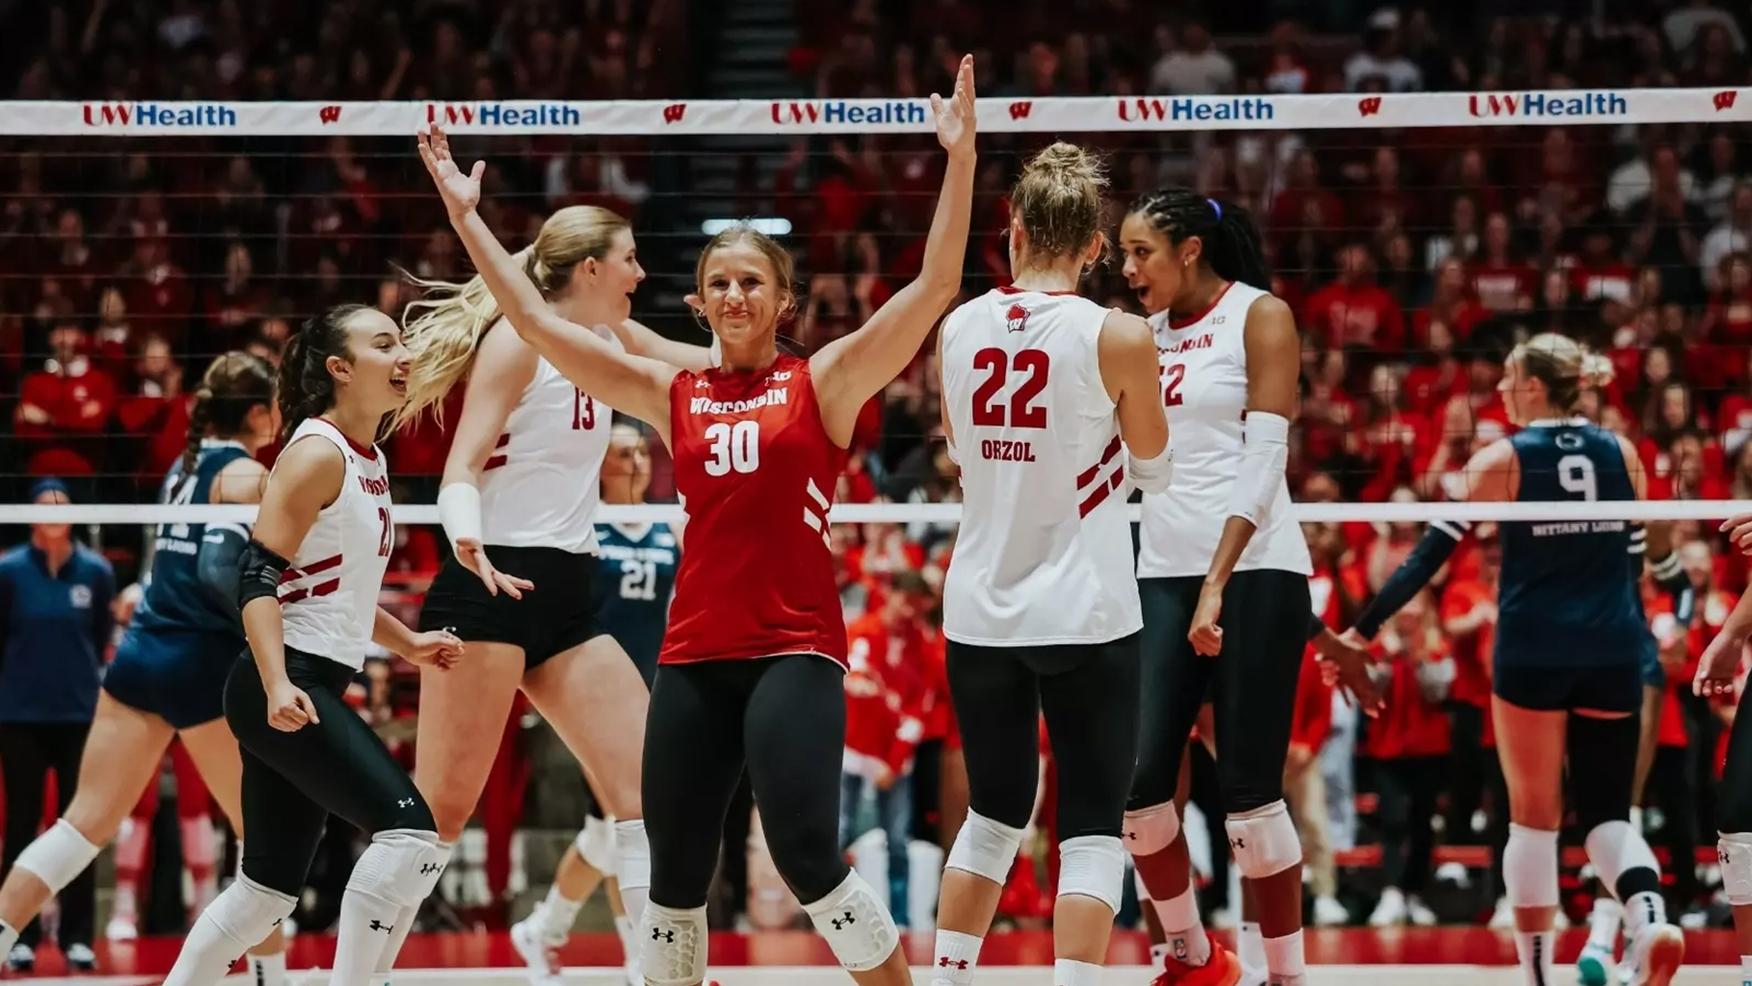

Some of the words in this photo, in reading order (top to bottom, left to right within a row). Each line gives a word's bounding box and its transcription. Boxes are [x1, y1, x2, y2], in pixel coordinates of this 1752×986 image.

[572, 385, 595, 430] 13
[690, 387, 788, 415] WISCONSIN
[972, 347, 1050, 429] 22
[704, 420, 760, 477] 30
[981, 440, 1036, 463] ORZOL
[1557, 454, 1598, 502] 9
[619, 560, 657, 600] 21
